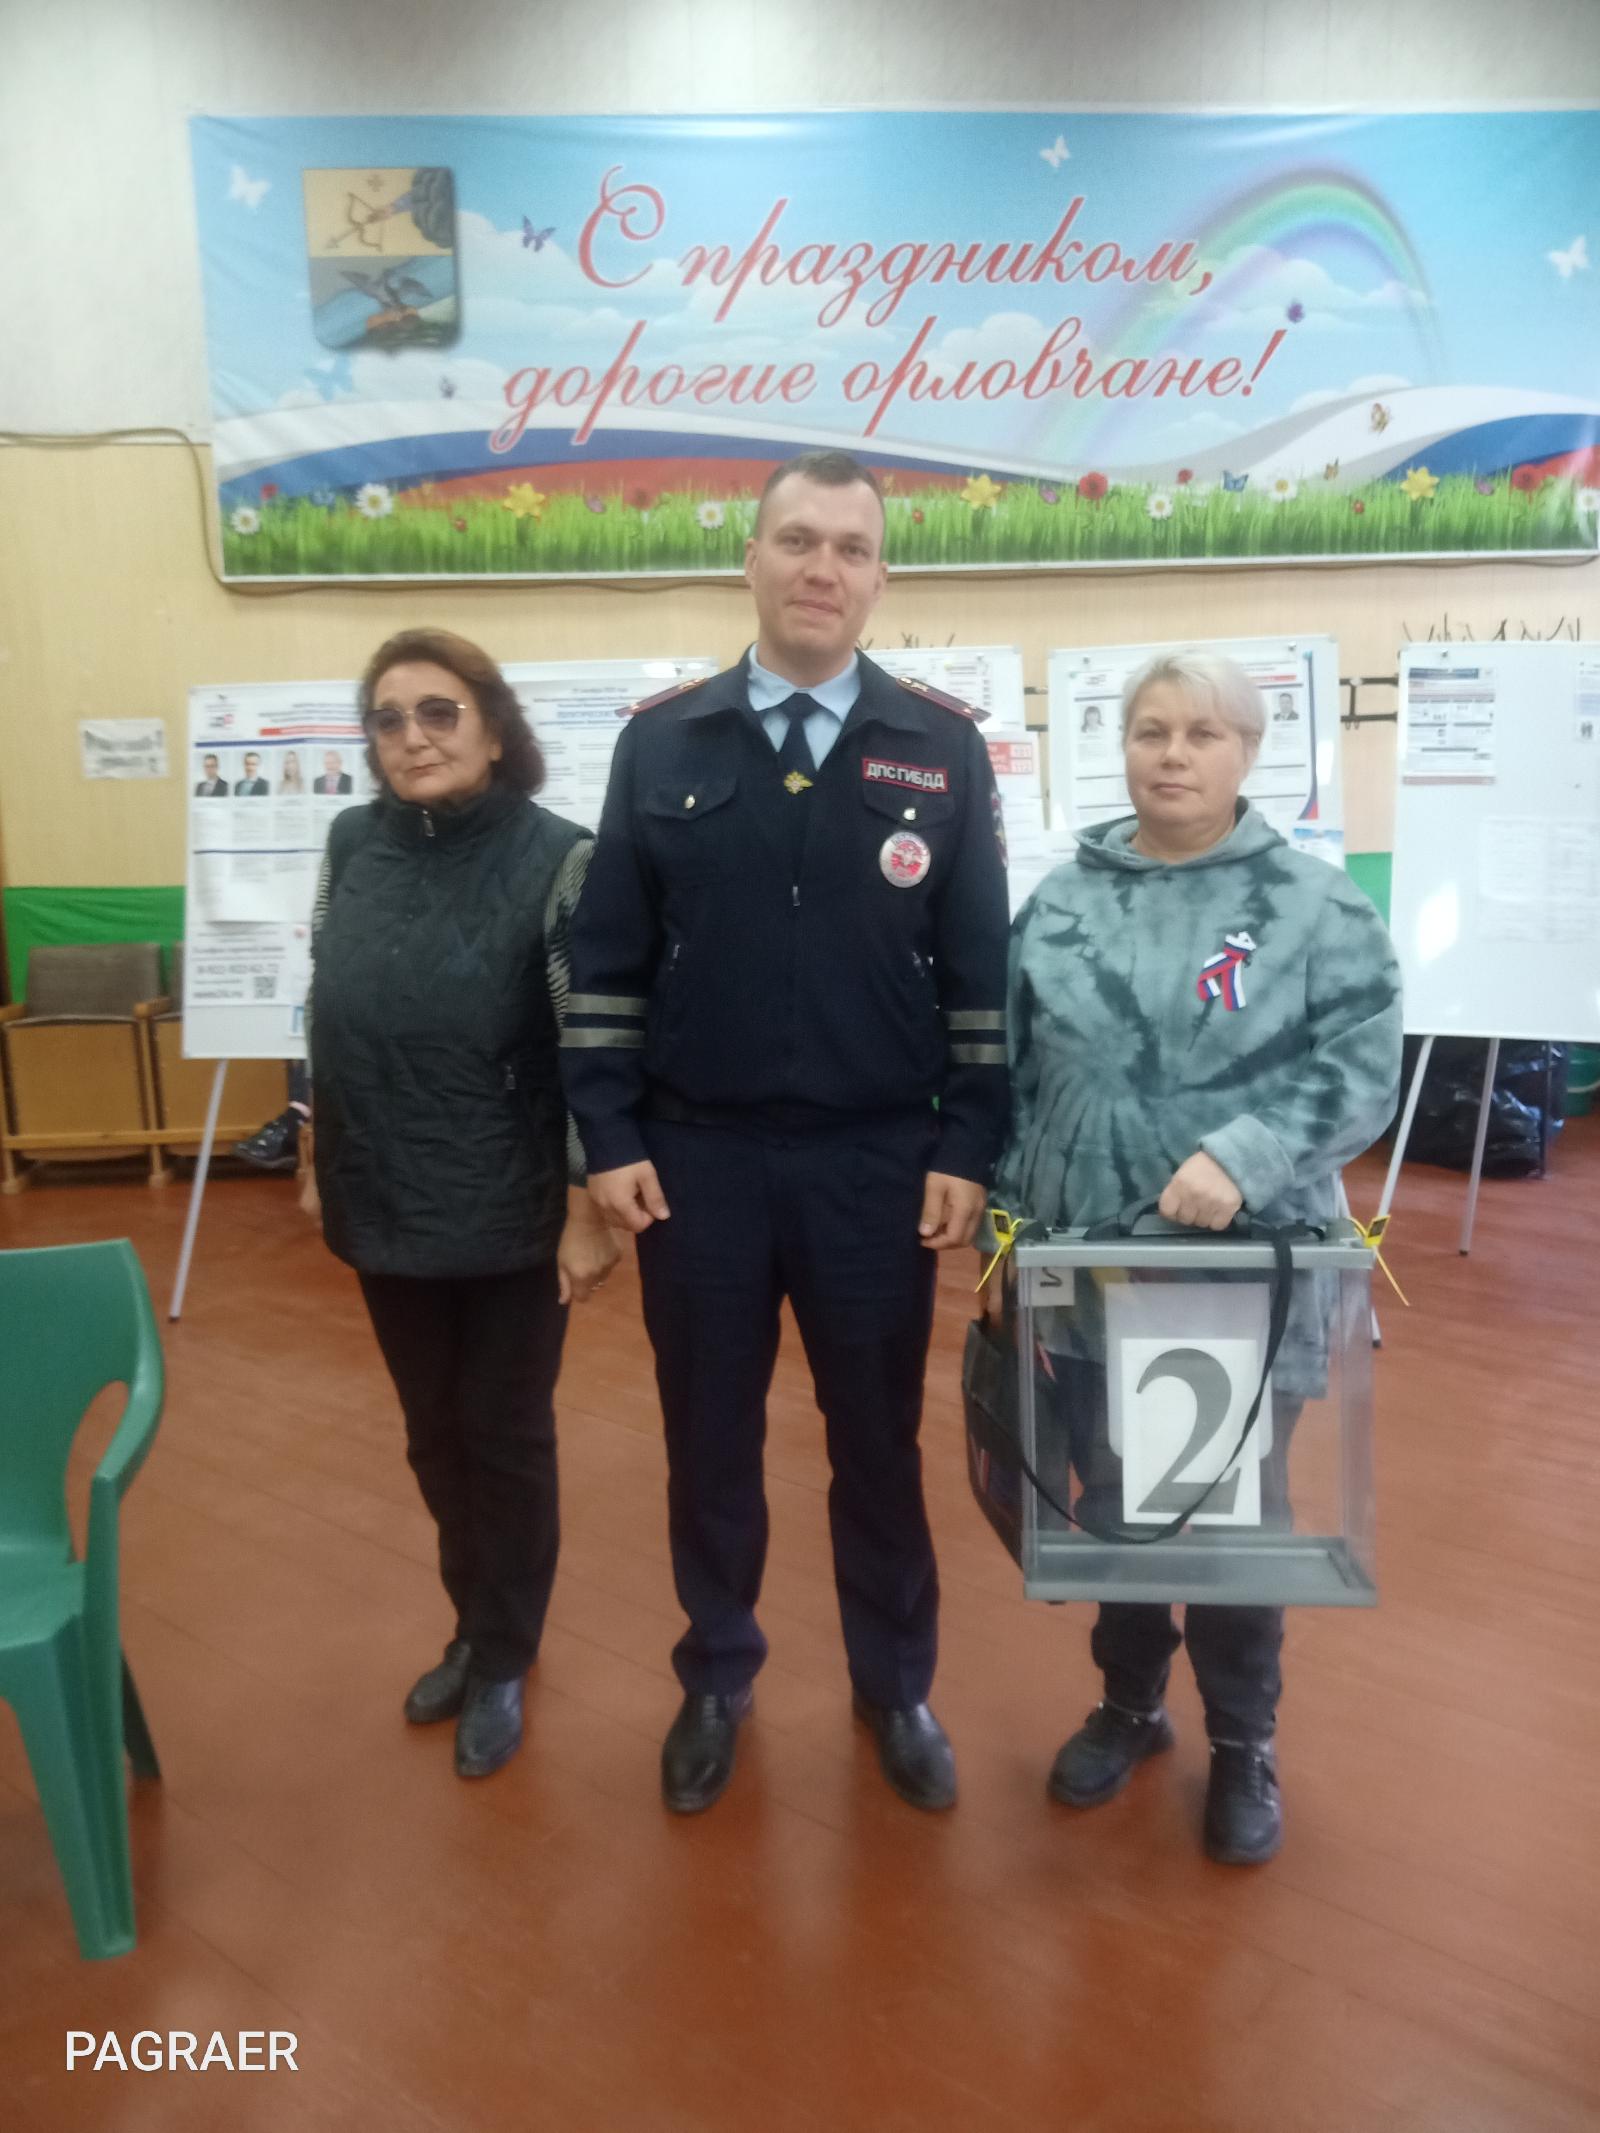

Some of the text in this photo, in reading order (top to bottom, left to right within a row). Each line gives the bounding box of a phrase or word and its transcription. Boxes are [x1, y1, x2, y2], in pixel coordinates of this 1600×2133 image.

[578, 166, 1215, 328] С праздником,
[488, 316, 1288, 454] дорогие орловчане!
[1136, 1347, 1241, 1514] 2
